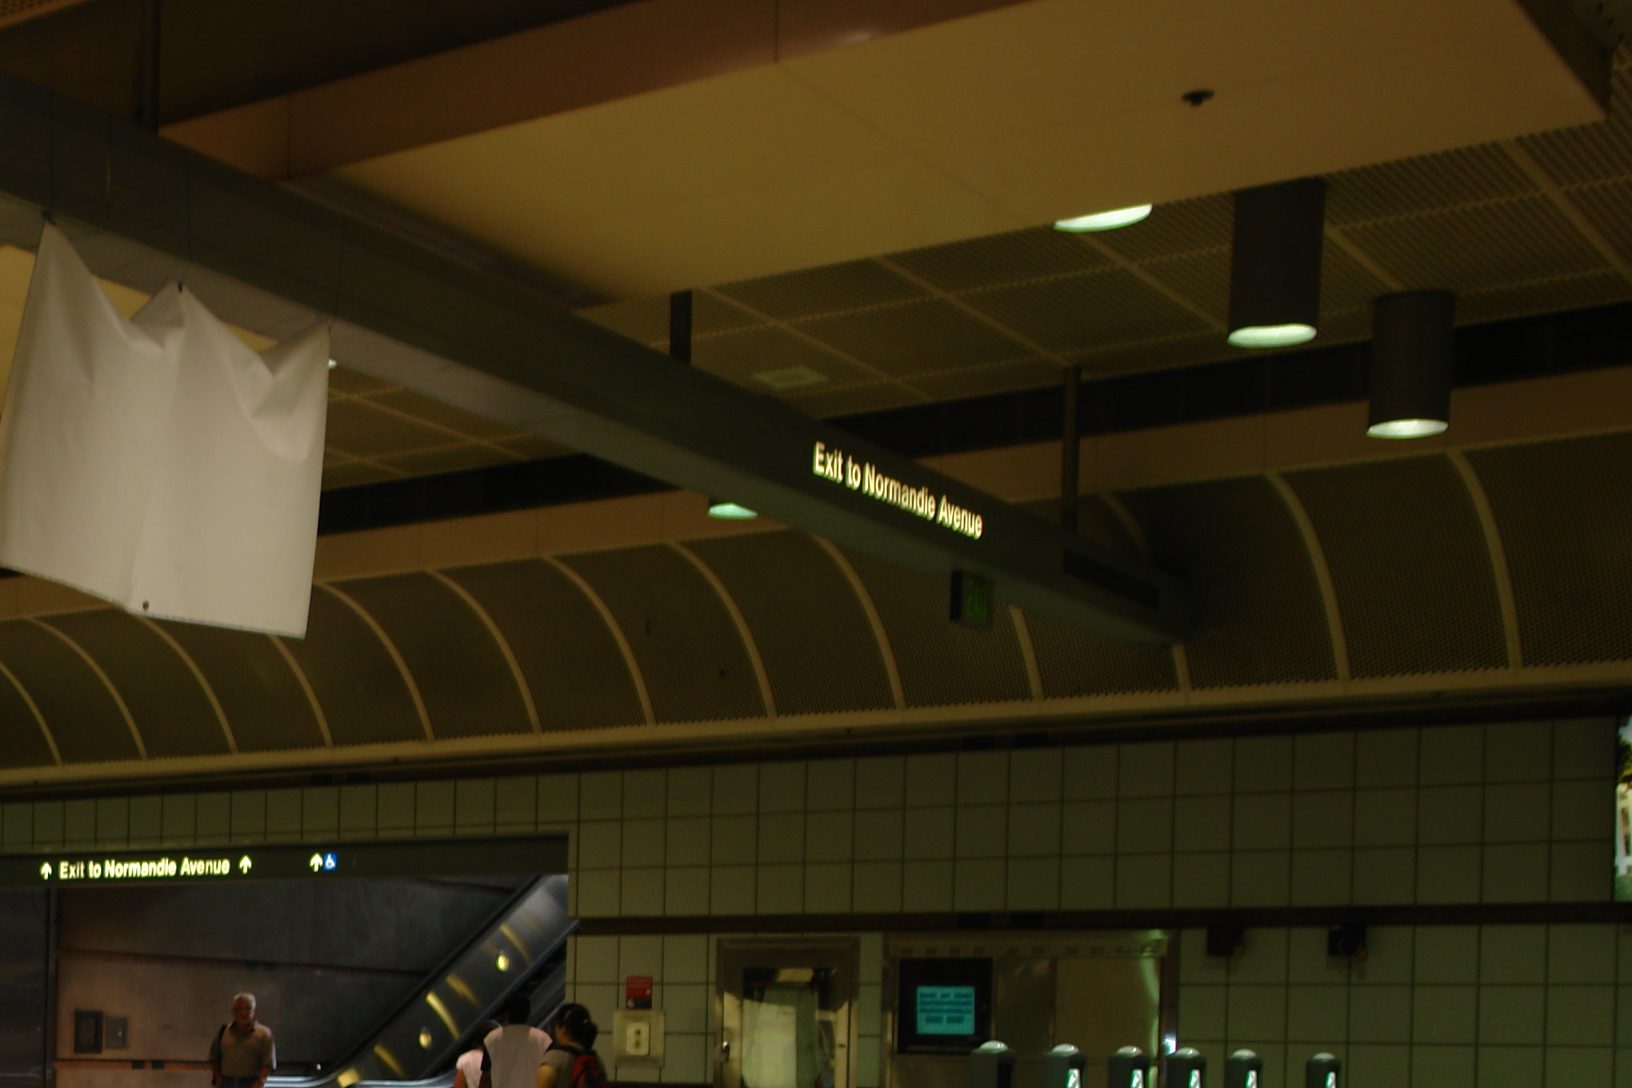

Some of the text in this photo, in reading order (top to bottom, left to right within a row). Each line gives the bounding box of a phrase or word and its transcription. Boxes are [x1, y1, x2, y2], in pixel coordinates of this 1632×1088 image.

[812, 440, 984, 540] Exit to Normandie Avenue
[58, 856, 231, 880] Exit to Normandie Avenue
